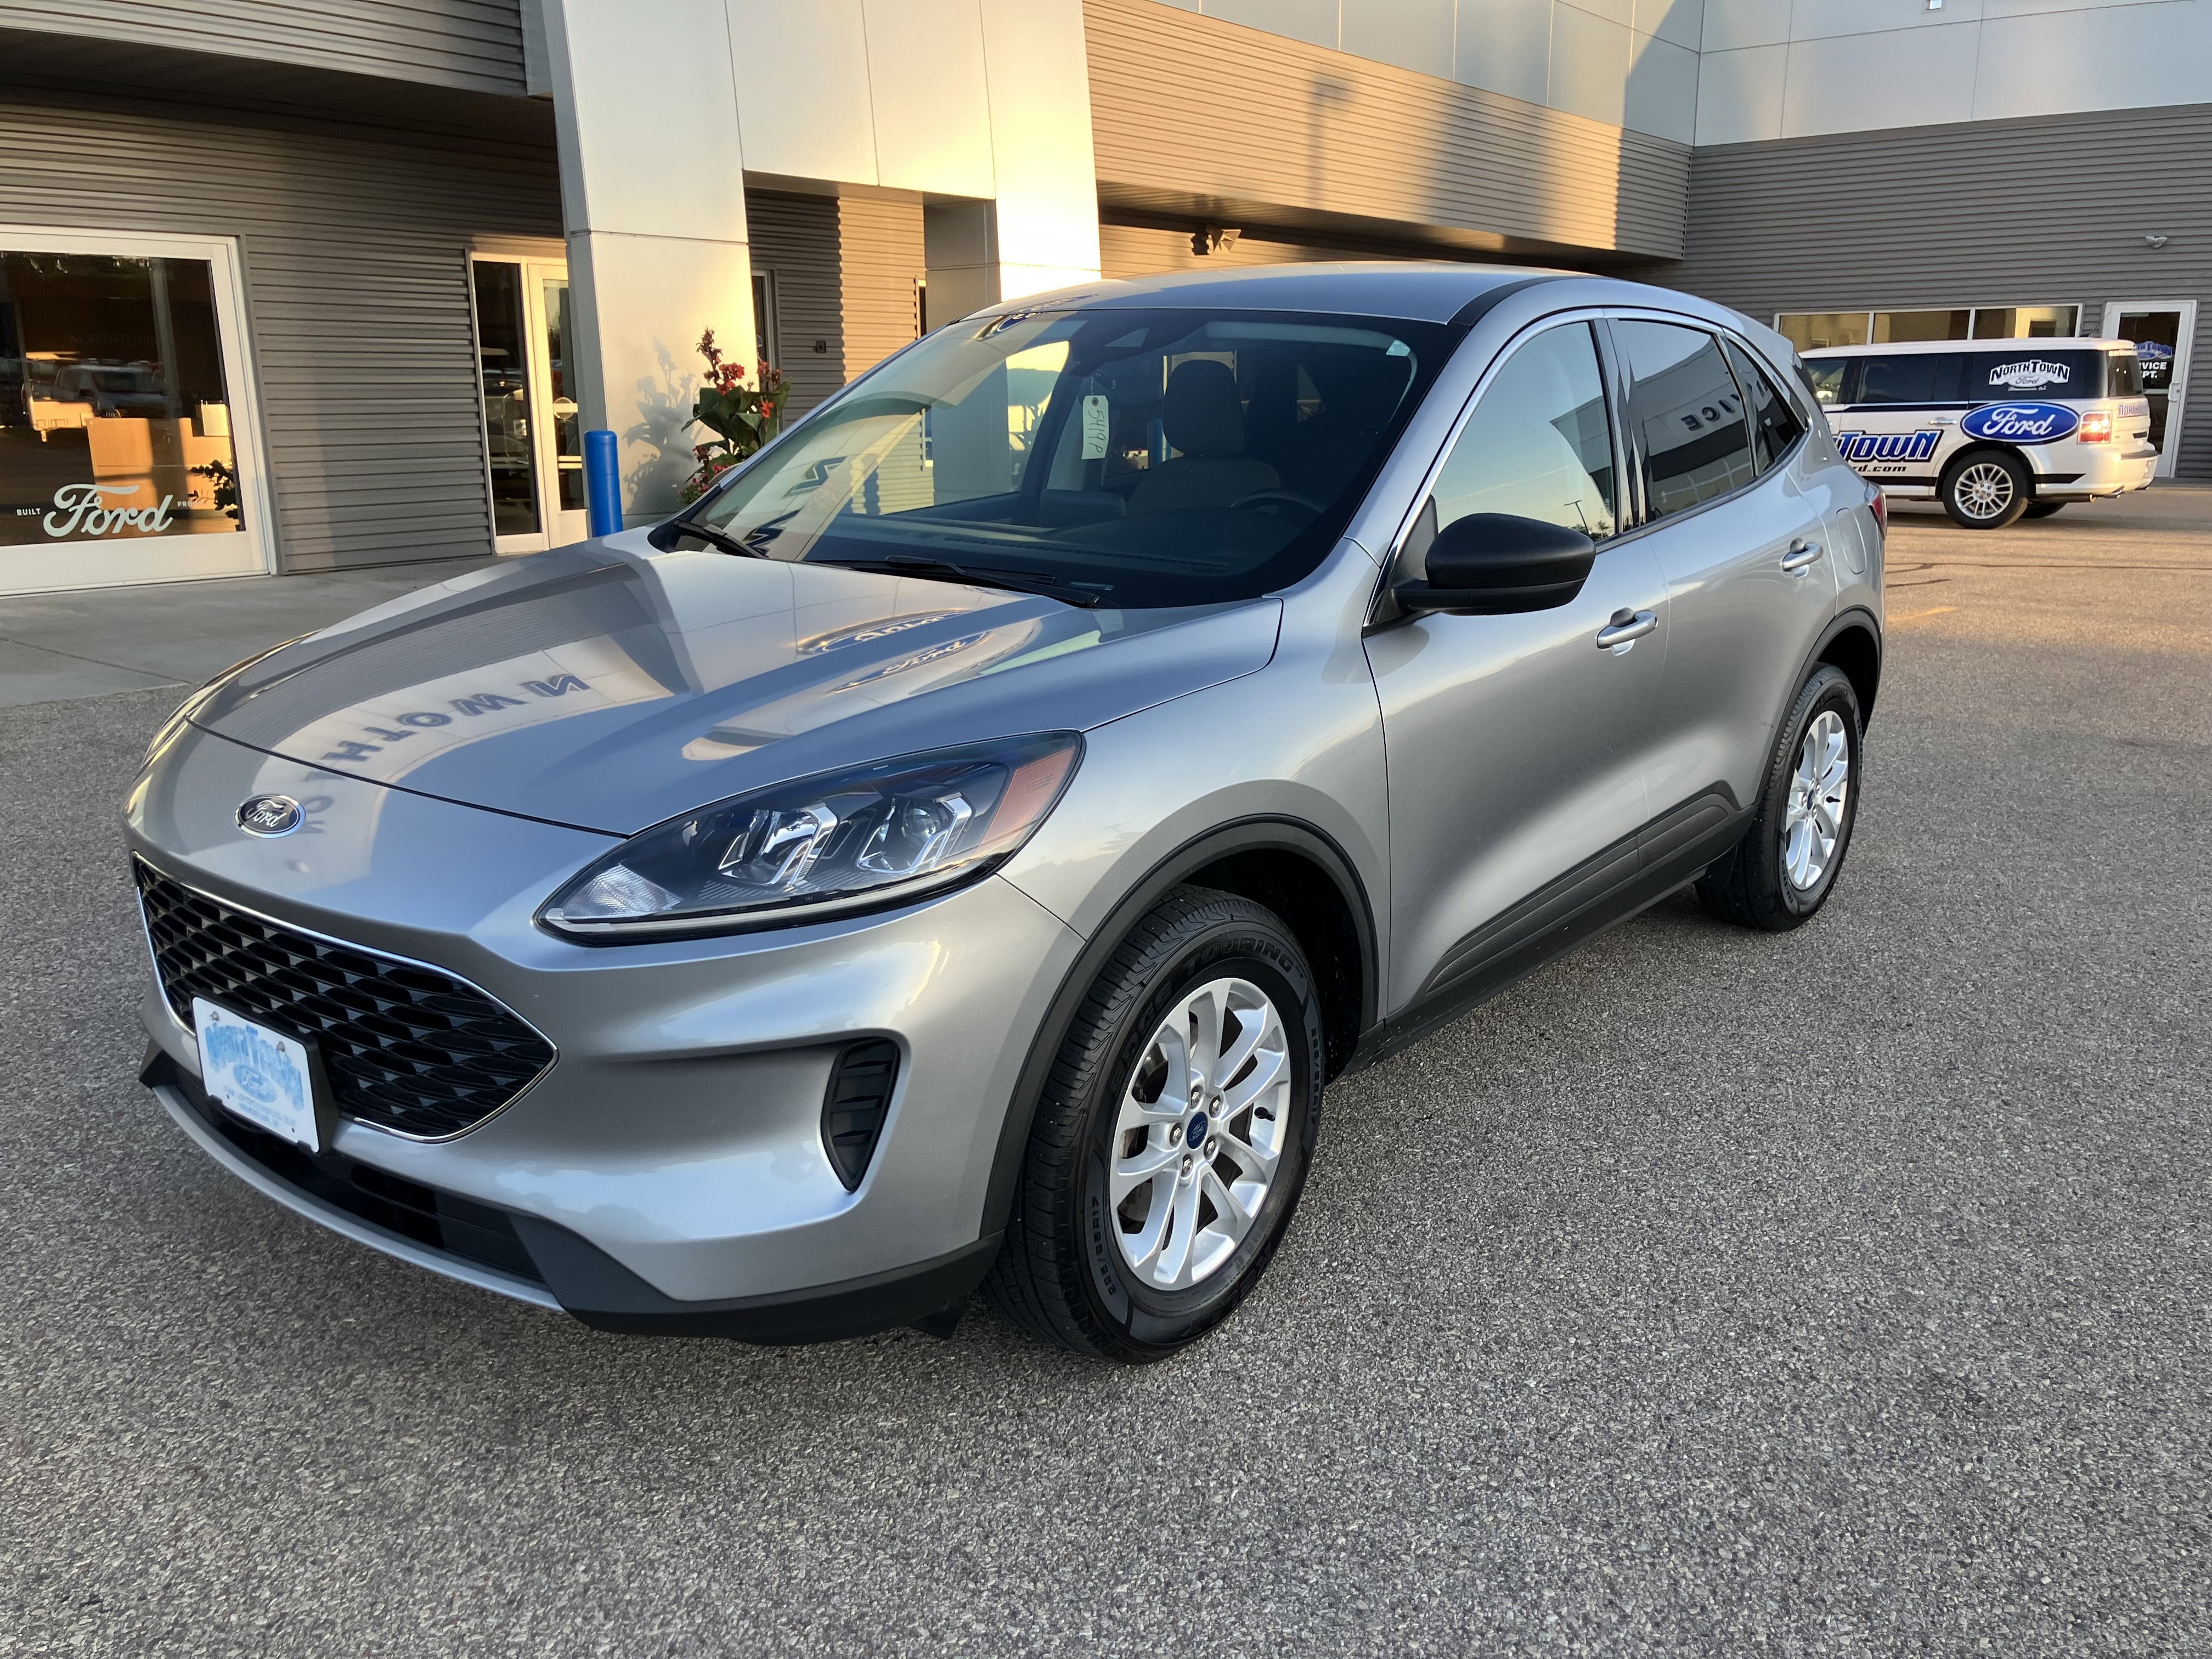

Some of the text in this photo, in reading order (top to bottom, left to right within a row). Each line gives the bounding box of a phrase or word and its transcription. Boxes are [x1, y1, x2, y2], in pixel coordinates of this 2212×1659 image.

[1991, 360, 2068, 382] NORTHTOWN
[1983, 408, 2056, 435] Ford
[1833, 430, 1943, 461] TOWN
[16, 484, 203, 537] BUILT Ford PRO
[246, 800, 287, 828] Ford
[1182, 936, 1295, 975] TOURING
